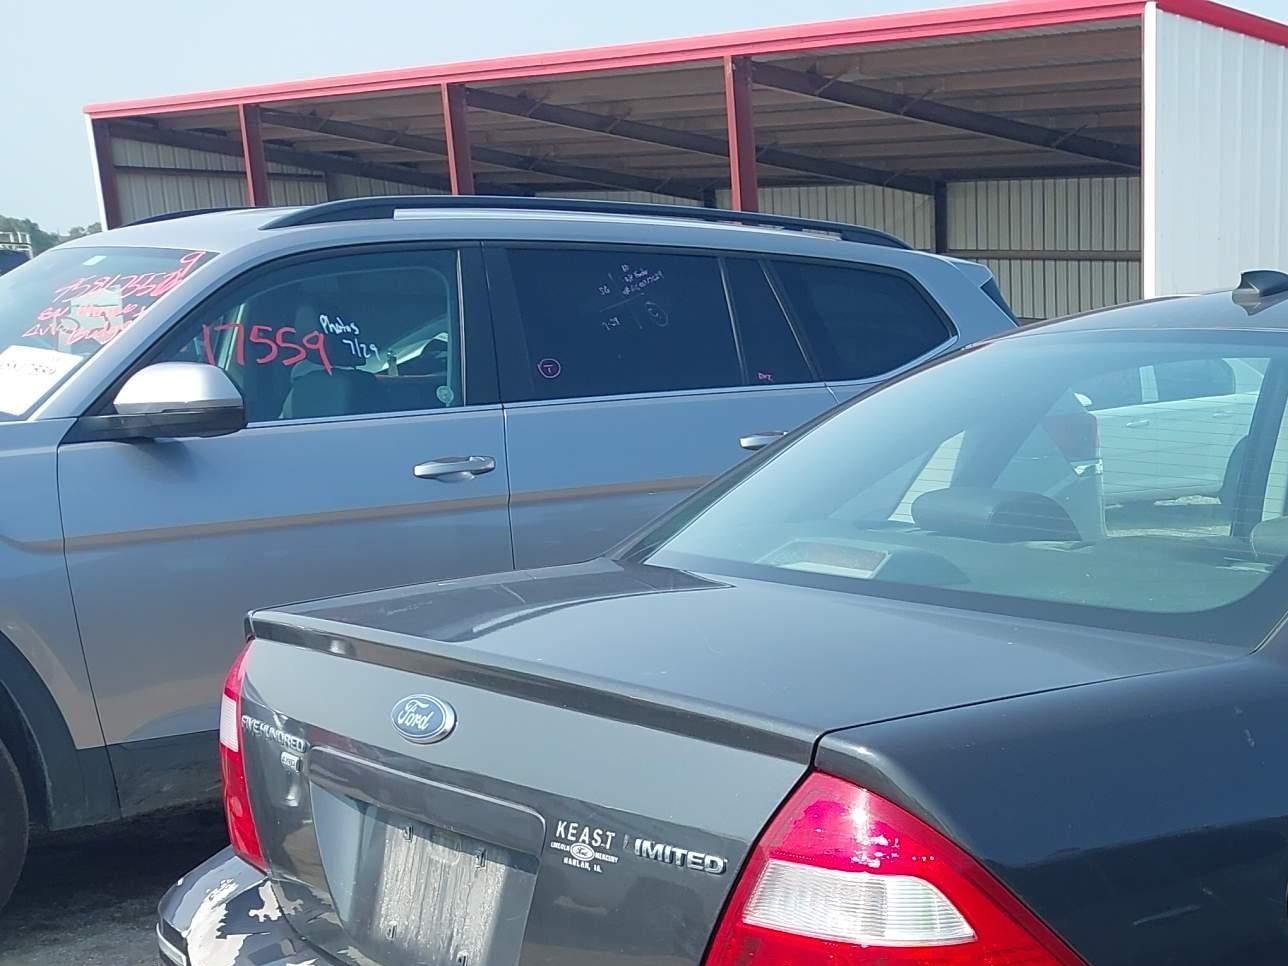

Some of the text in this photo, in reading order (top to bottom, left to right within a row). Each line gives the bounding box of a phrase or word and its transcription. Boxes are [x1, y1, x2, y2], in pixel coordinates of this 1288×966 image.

[320, 314, 359, 335] Photos
[202, 324, 332, 375] 17559
[342, 337, 380, 361] 7/29
[398, 699, 435, 730] Ford
[556, 820, 616, 849] KEAST
